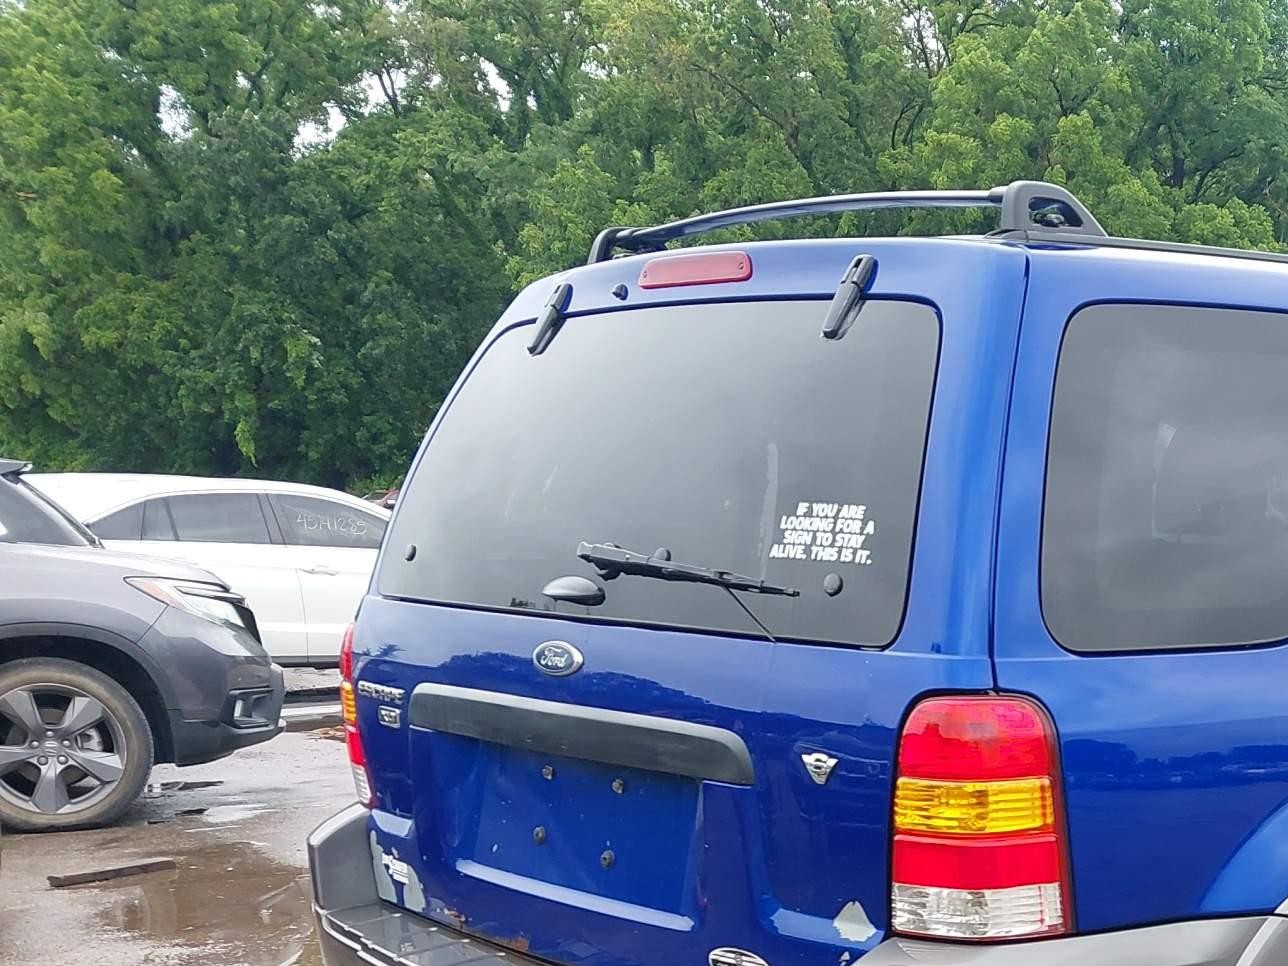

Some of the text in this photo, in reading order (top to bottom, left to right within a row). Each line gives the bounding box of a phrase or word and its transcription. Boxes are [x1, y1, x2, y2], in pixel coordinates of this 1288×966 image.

[796, 502, 867, 519] IF YOU ARE
[780, 515, 876, 535] LOOKING FOR A
[782, 530, 866, 549] SIGN TO STAY
[810, 546, 839, 562] THIS
[840, 550, 854, 563] IS
[854, 550, 873, 565] IT.
